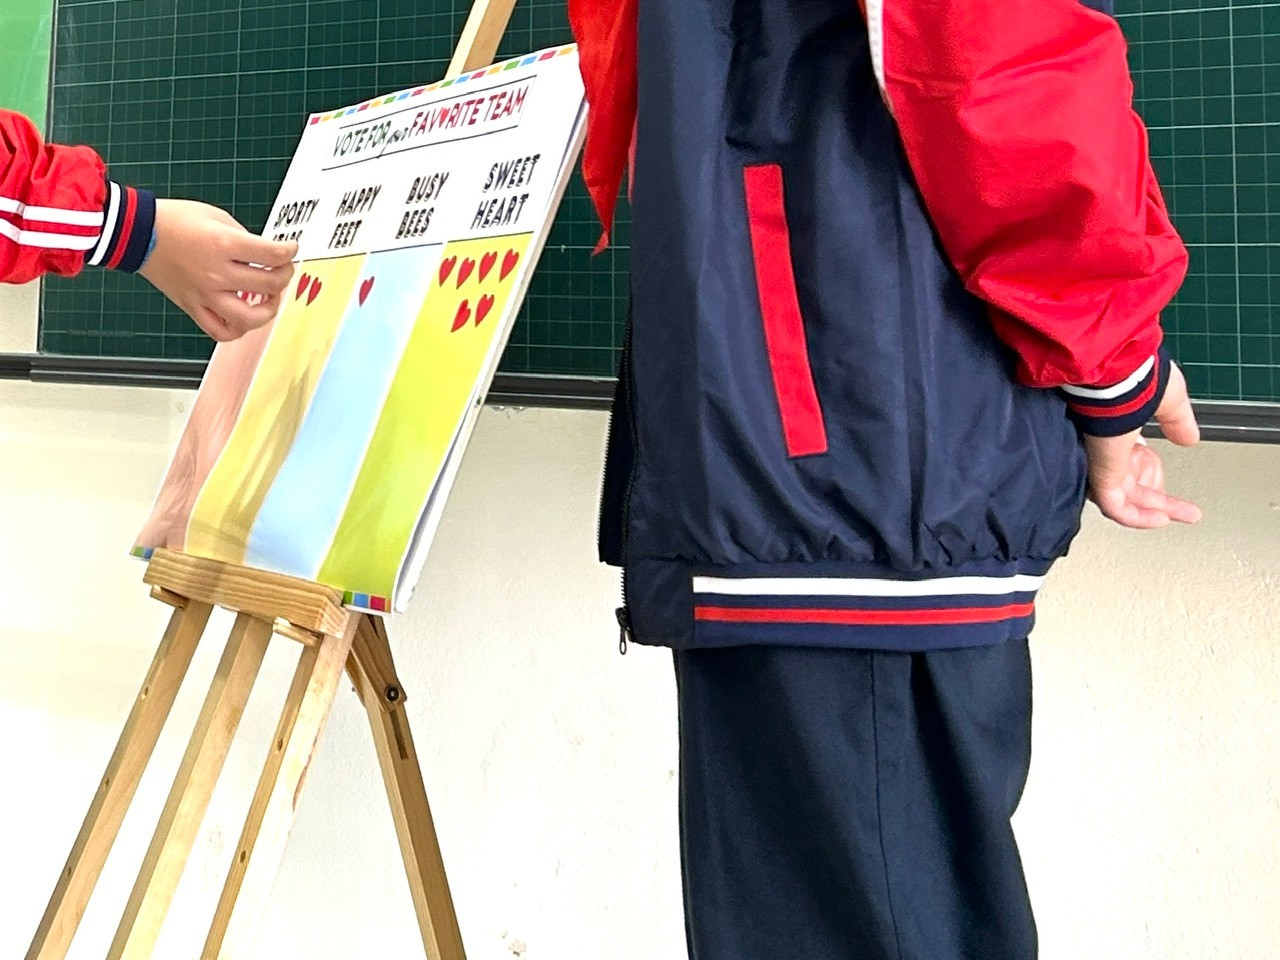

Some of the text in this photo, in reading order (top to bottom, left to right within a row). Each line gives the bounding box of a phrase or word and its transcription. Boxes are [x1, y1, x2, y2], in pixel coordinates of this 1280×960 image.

[333, 127, 370, 158] VOTE
[364, 120, 392, 151] FOR
[483, 85, 530, 122] TEAM
[406, 171, 450, 204] BUSY
[482, 153, 541, 193] SWEET
[273, 198, 320, 230] SPORTY
[336, 184, 382, 217] HAPPY
[470, 193, 529, 230] HEART
[328, 219, 362, 249] FEET
[395, 207, 434, 239] BEES
